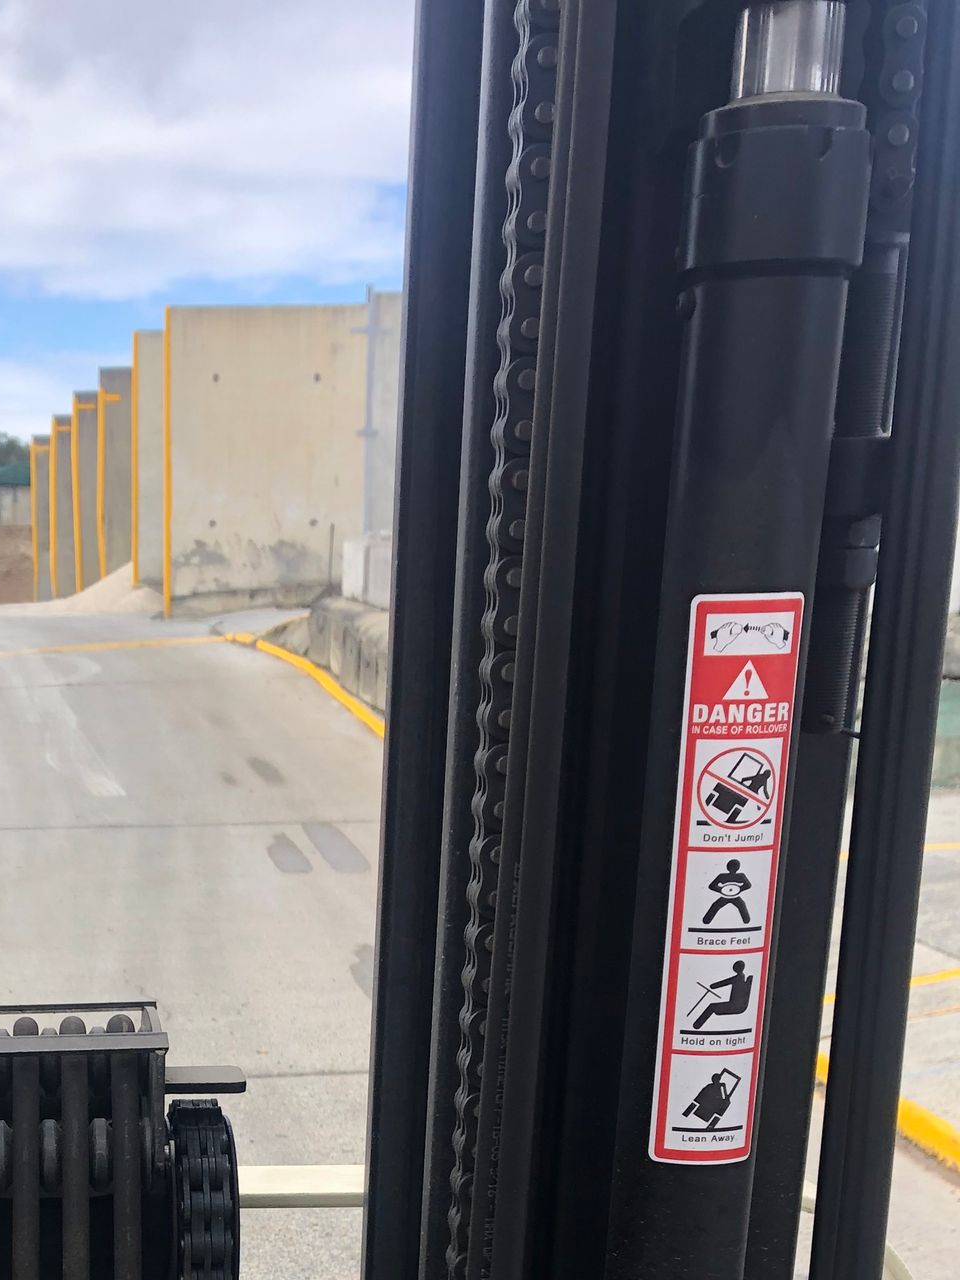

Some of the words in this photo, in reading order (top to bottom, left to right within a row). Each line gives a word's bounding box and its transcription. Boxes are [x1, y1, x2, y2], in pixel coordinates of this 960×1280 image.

[692, 702, 789, 723] DANGER
[691, 725, 701, 734] IN
[702, 724, 728, 735] CASE
[730, 724, 743, 734] OF
[745, 723, 788, 734] ROLLOVER
[702, 833, 731, 843] Don't
[734, 832, 764, 843] Jump!
[696, 937, 727, 946] Brace
[730, 937, 751, 946] Feet
[680, 1037, 706, 1047] Hold
[709, 1038, 723, 1046] on
[725, 1036, 746, 1047] tight
[681, 1134, 707, 1143] Lean
[710, 1133, 735, 1144] Away
